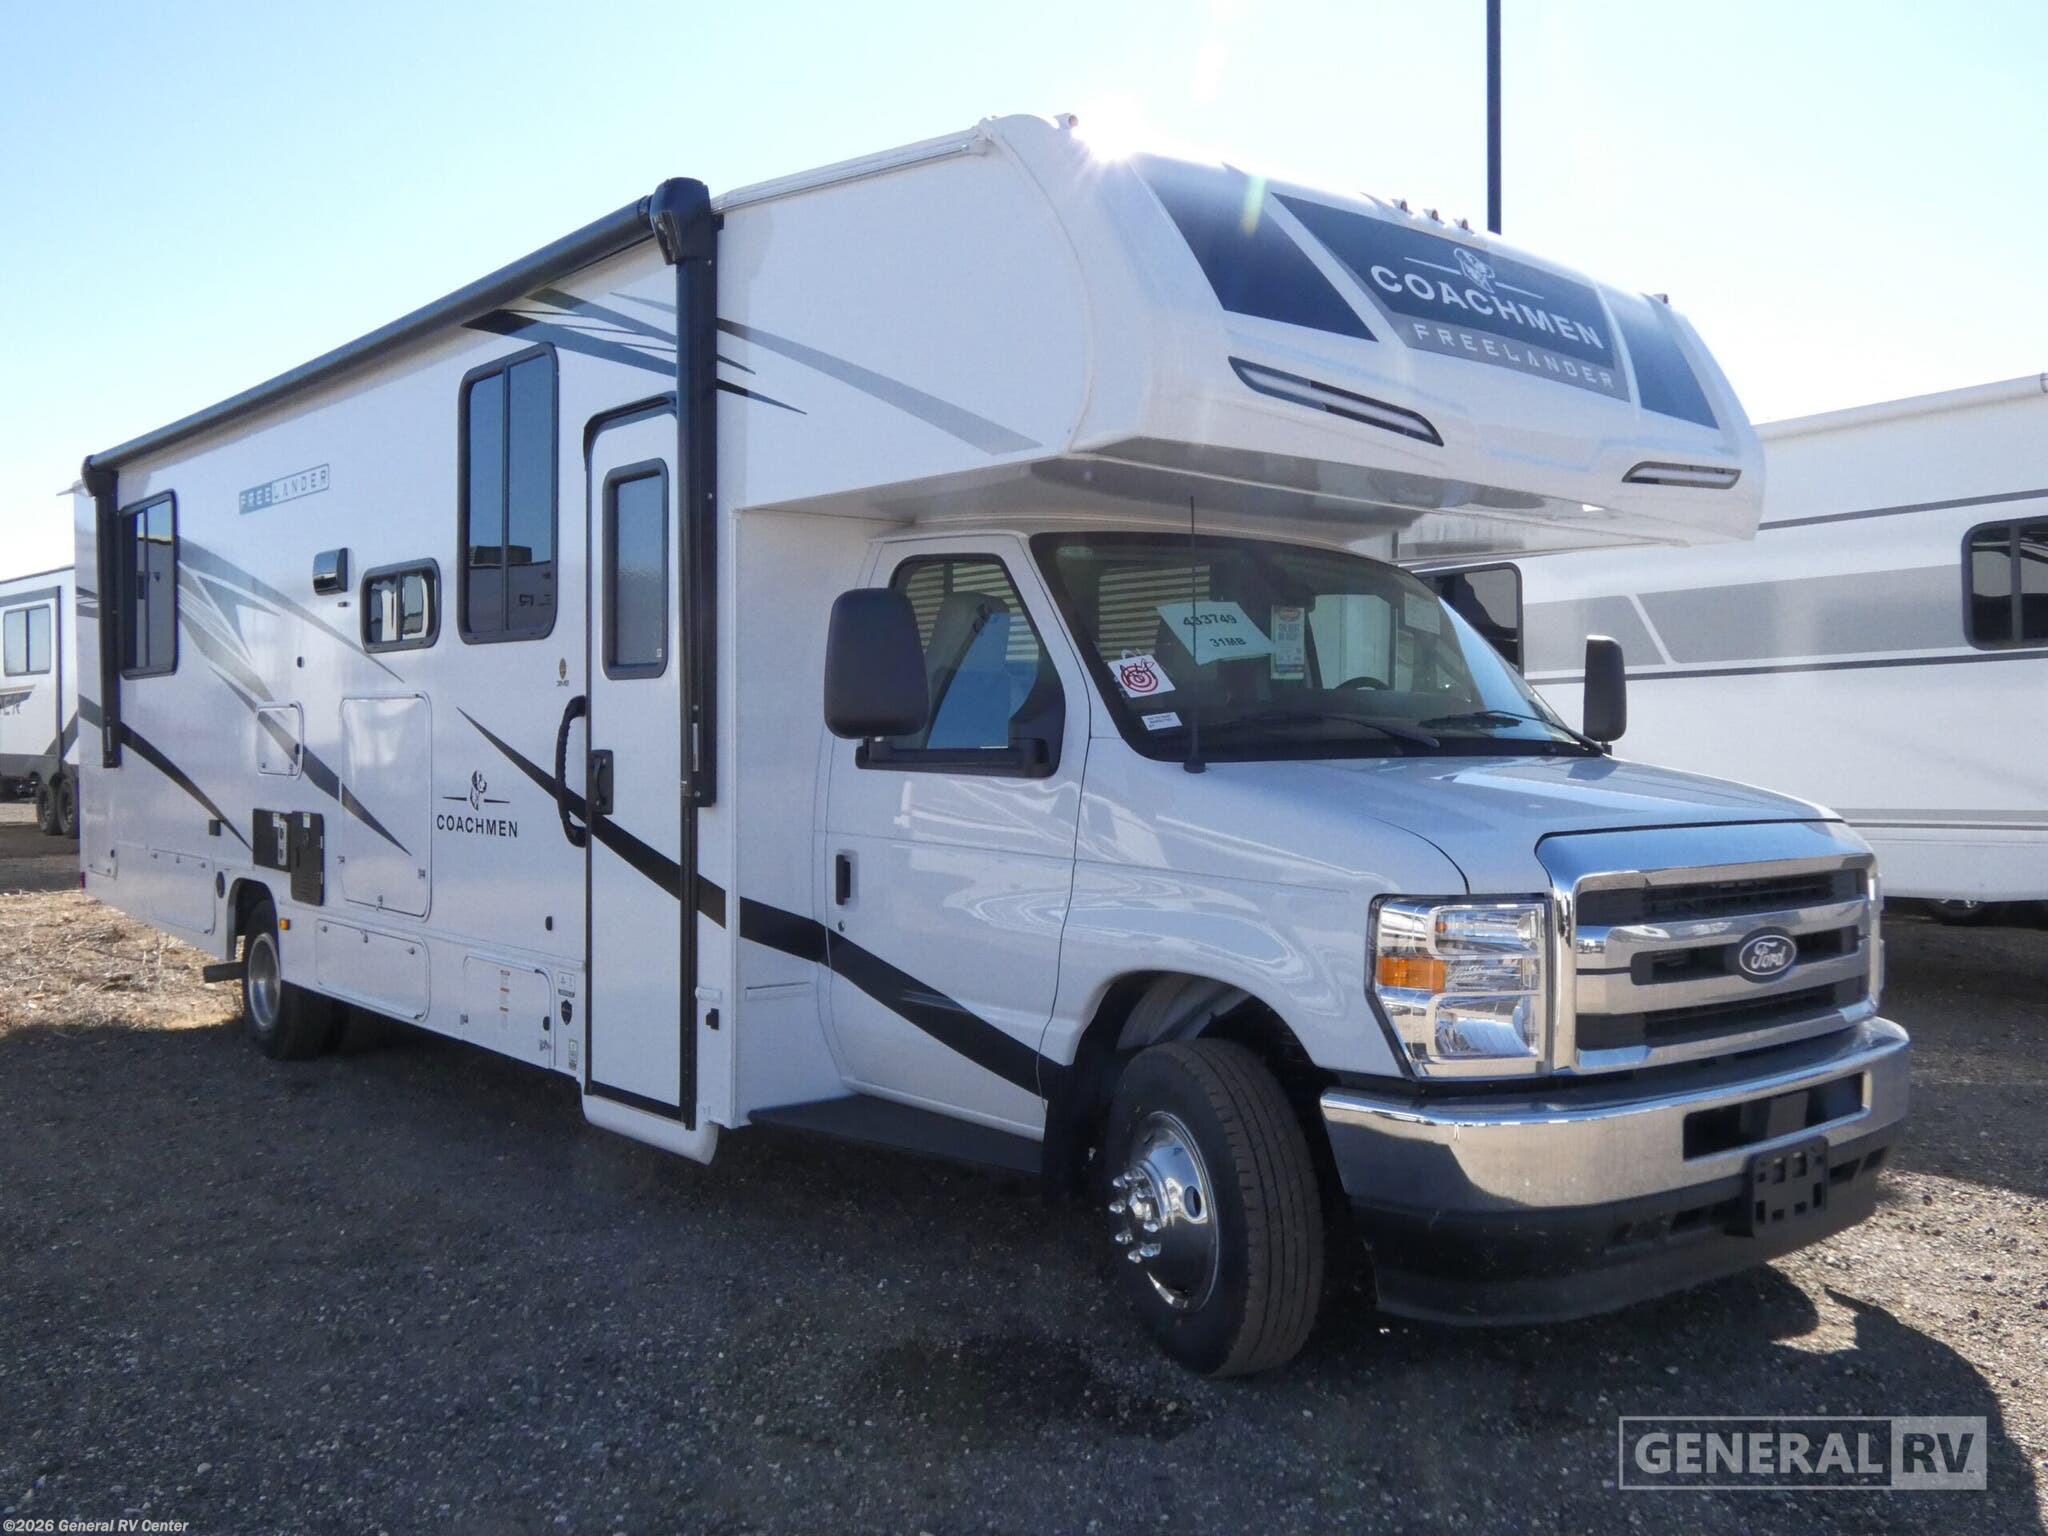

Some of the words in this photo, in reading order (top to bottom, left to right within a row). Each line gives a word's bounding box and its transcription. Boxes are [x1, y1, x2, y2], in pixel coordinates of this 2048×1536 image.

[1370, 265, 1604, 349] COACHMEN
[1413, 322, 1615, 389] FREELANDER
[240, 469, 327, 507] FREELANDER
[436, 814, 518, 838] COACHMEN
[1751, 941, 1787, 970] Ford
